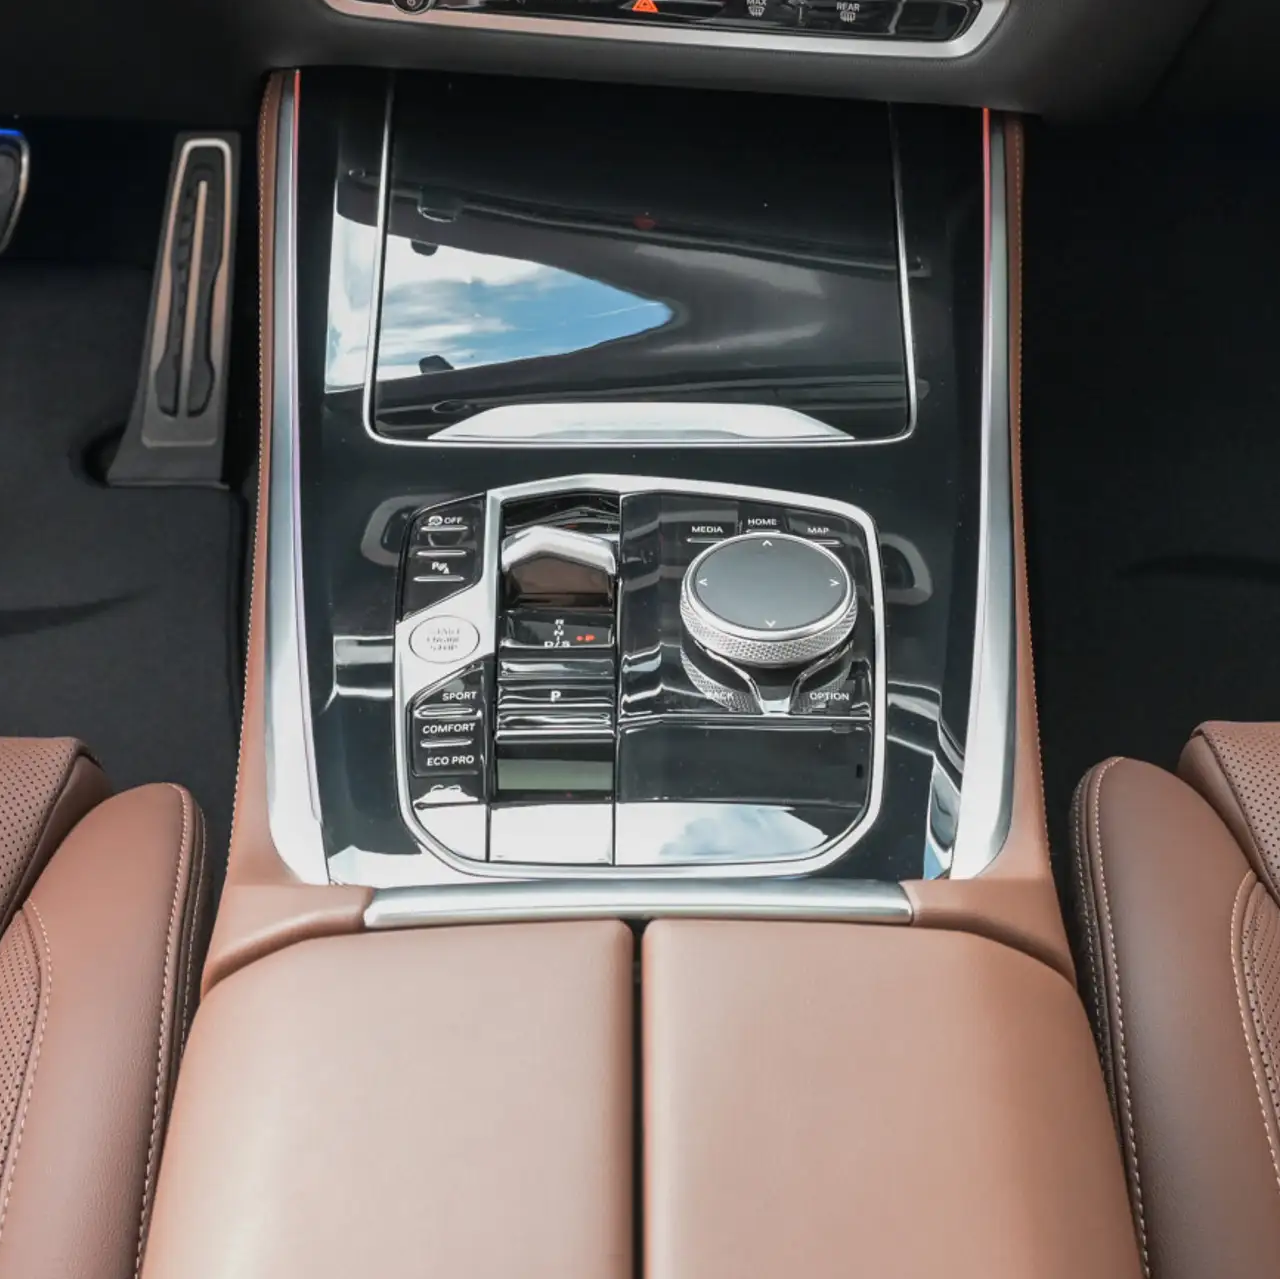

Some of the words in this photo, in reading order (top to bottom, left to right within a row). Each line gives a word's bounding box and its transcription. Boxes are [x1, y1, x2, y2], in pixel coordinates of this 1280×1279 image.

[836, 1, 861, 13] REAR
[443, 516, 463, 525] OFF
[747, 518, 778, 526] HOME
[691, 525, 724, 534] MEDIA
[441, 691, 477, 702] SPORT
[550, 690, 562, 703] P
[809, 691, 850, 701] OPTION
[422, 722, 476, 734] COMFORT
[426, 756, 450, 766] ECO
[451, 754, 475, 765] PRO
